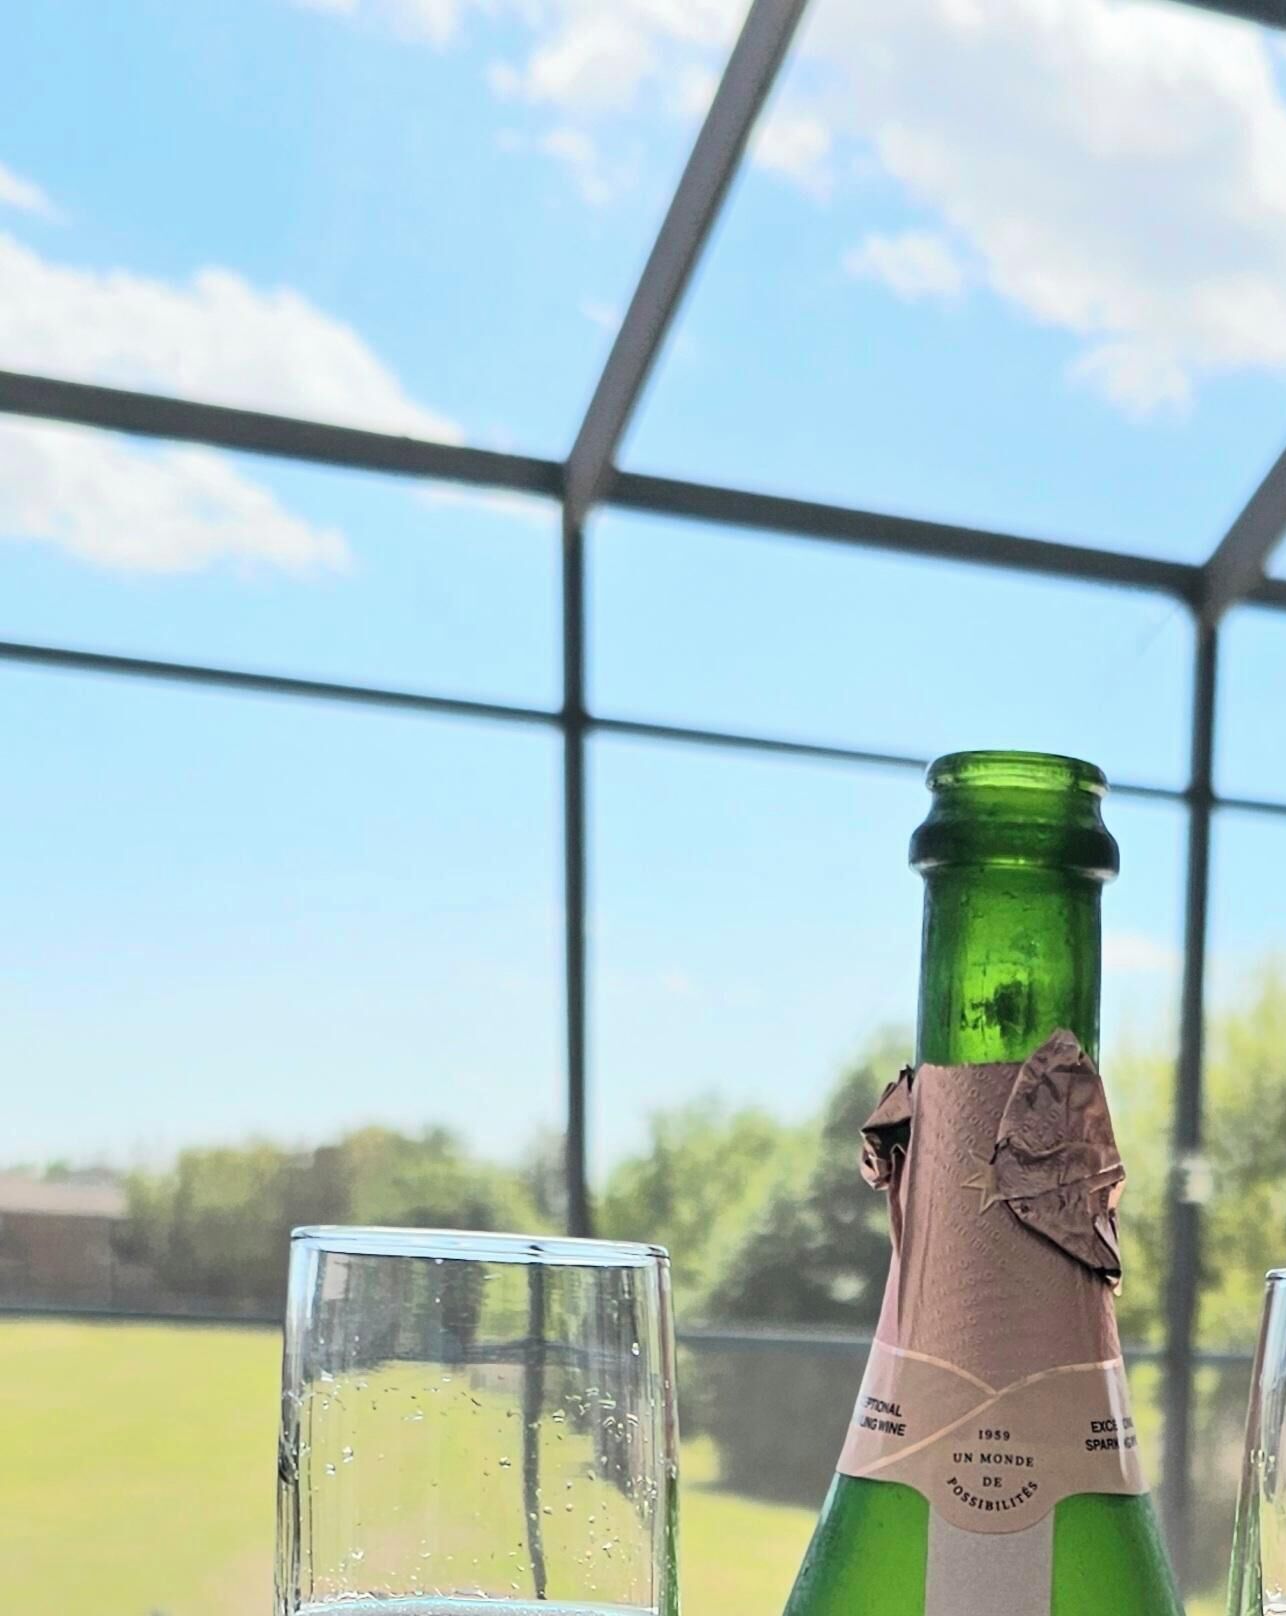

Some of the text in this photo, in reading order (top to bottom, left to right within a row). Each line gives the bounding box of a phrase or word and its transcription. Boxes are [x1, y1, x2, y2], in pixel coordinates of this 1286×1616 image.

[878, 1420, 906, 1437] WINE
[978, 1430, 1010, 1441] 1959
[953, 1452, 1034, 1467] UN MONDE
[982, 1476, 1002, 1488] DE
